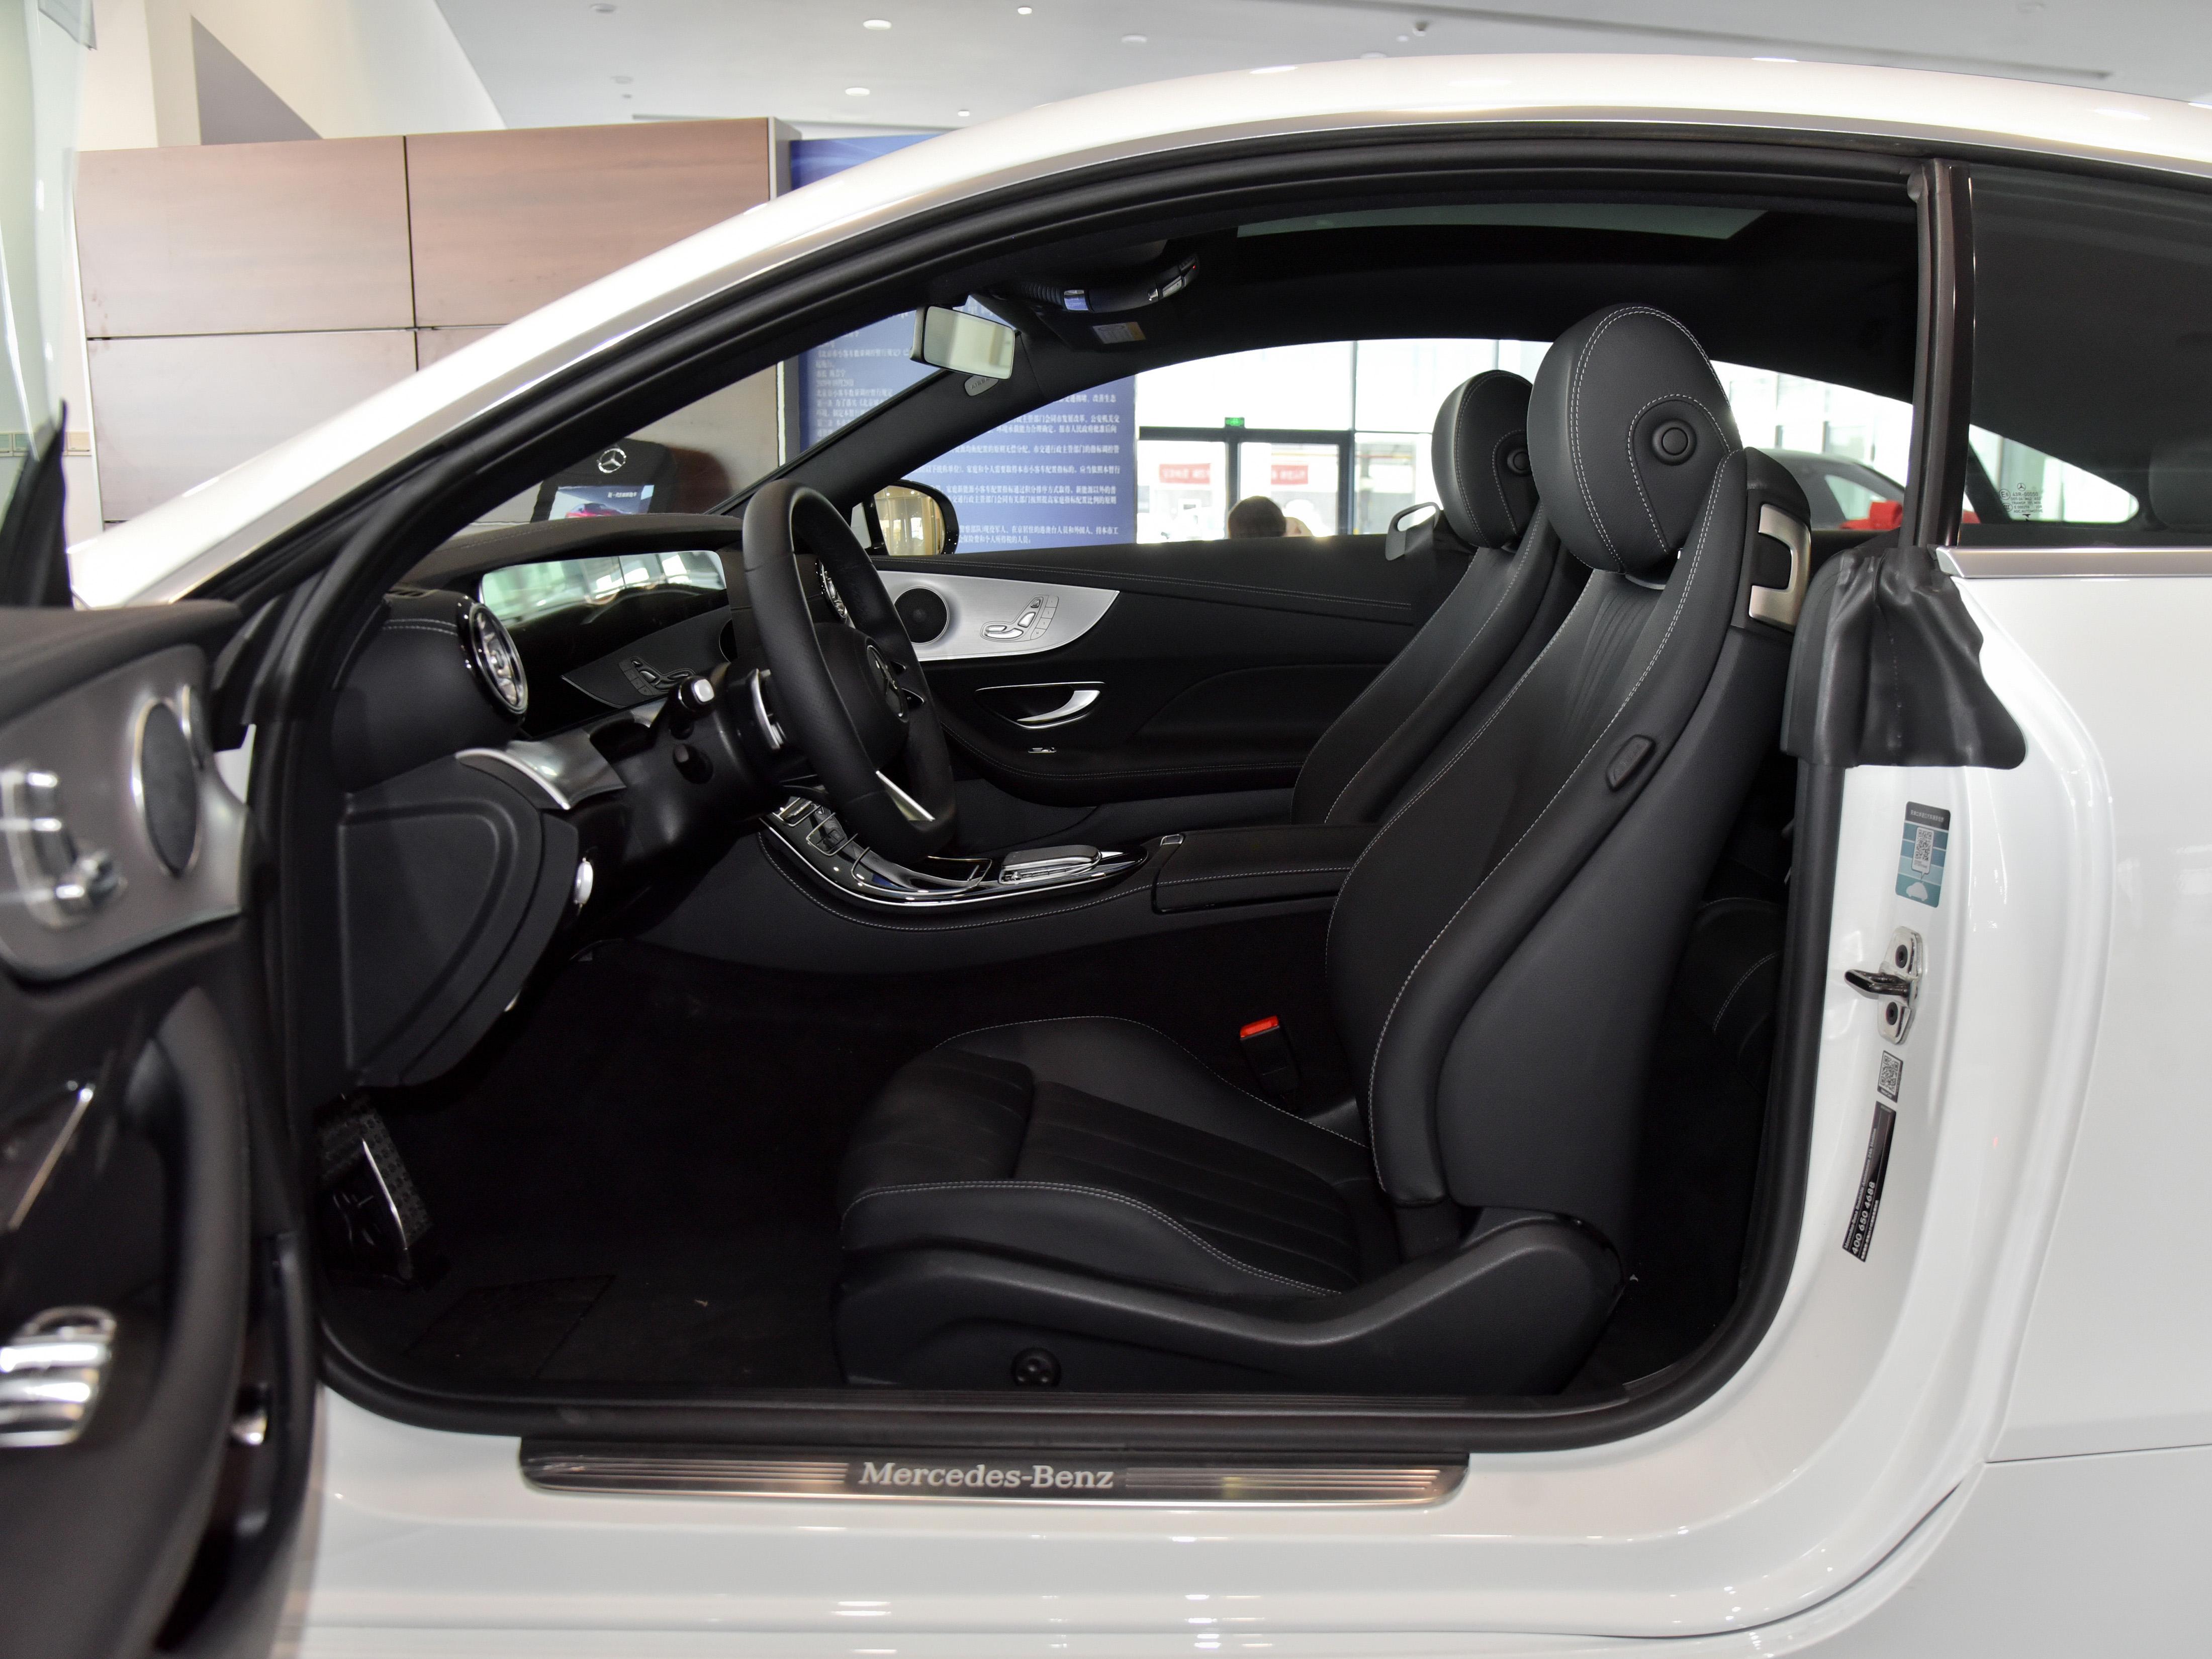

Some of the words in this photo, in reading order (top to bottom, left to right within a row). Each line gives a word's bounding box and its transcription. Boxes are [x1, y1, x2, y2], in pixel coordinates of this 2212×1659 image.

[1852, 1233, 1863, 1255] 400
[1858, 1211, 1869, 1233] 650
[1864, 1181, 1876, 1209] 4688
[858, 1461, 1114, 1489] Mercedes-Benz
